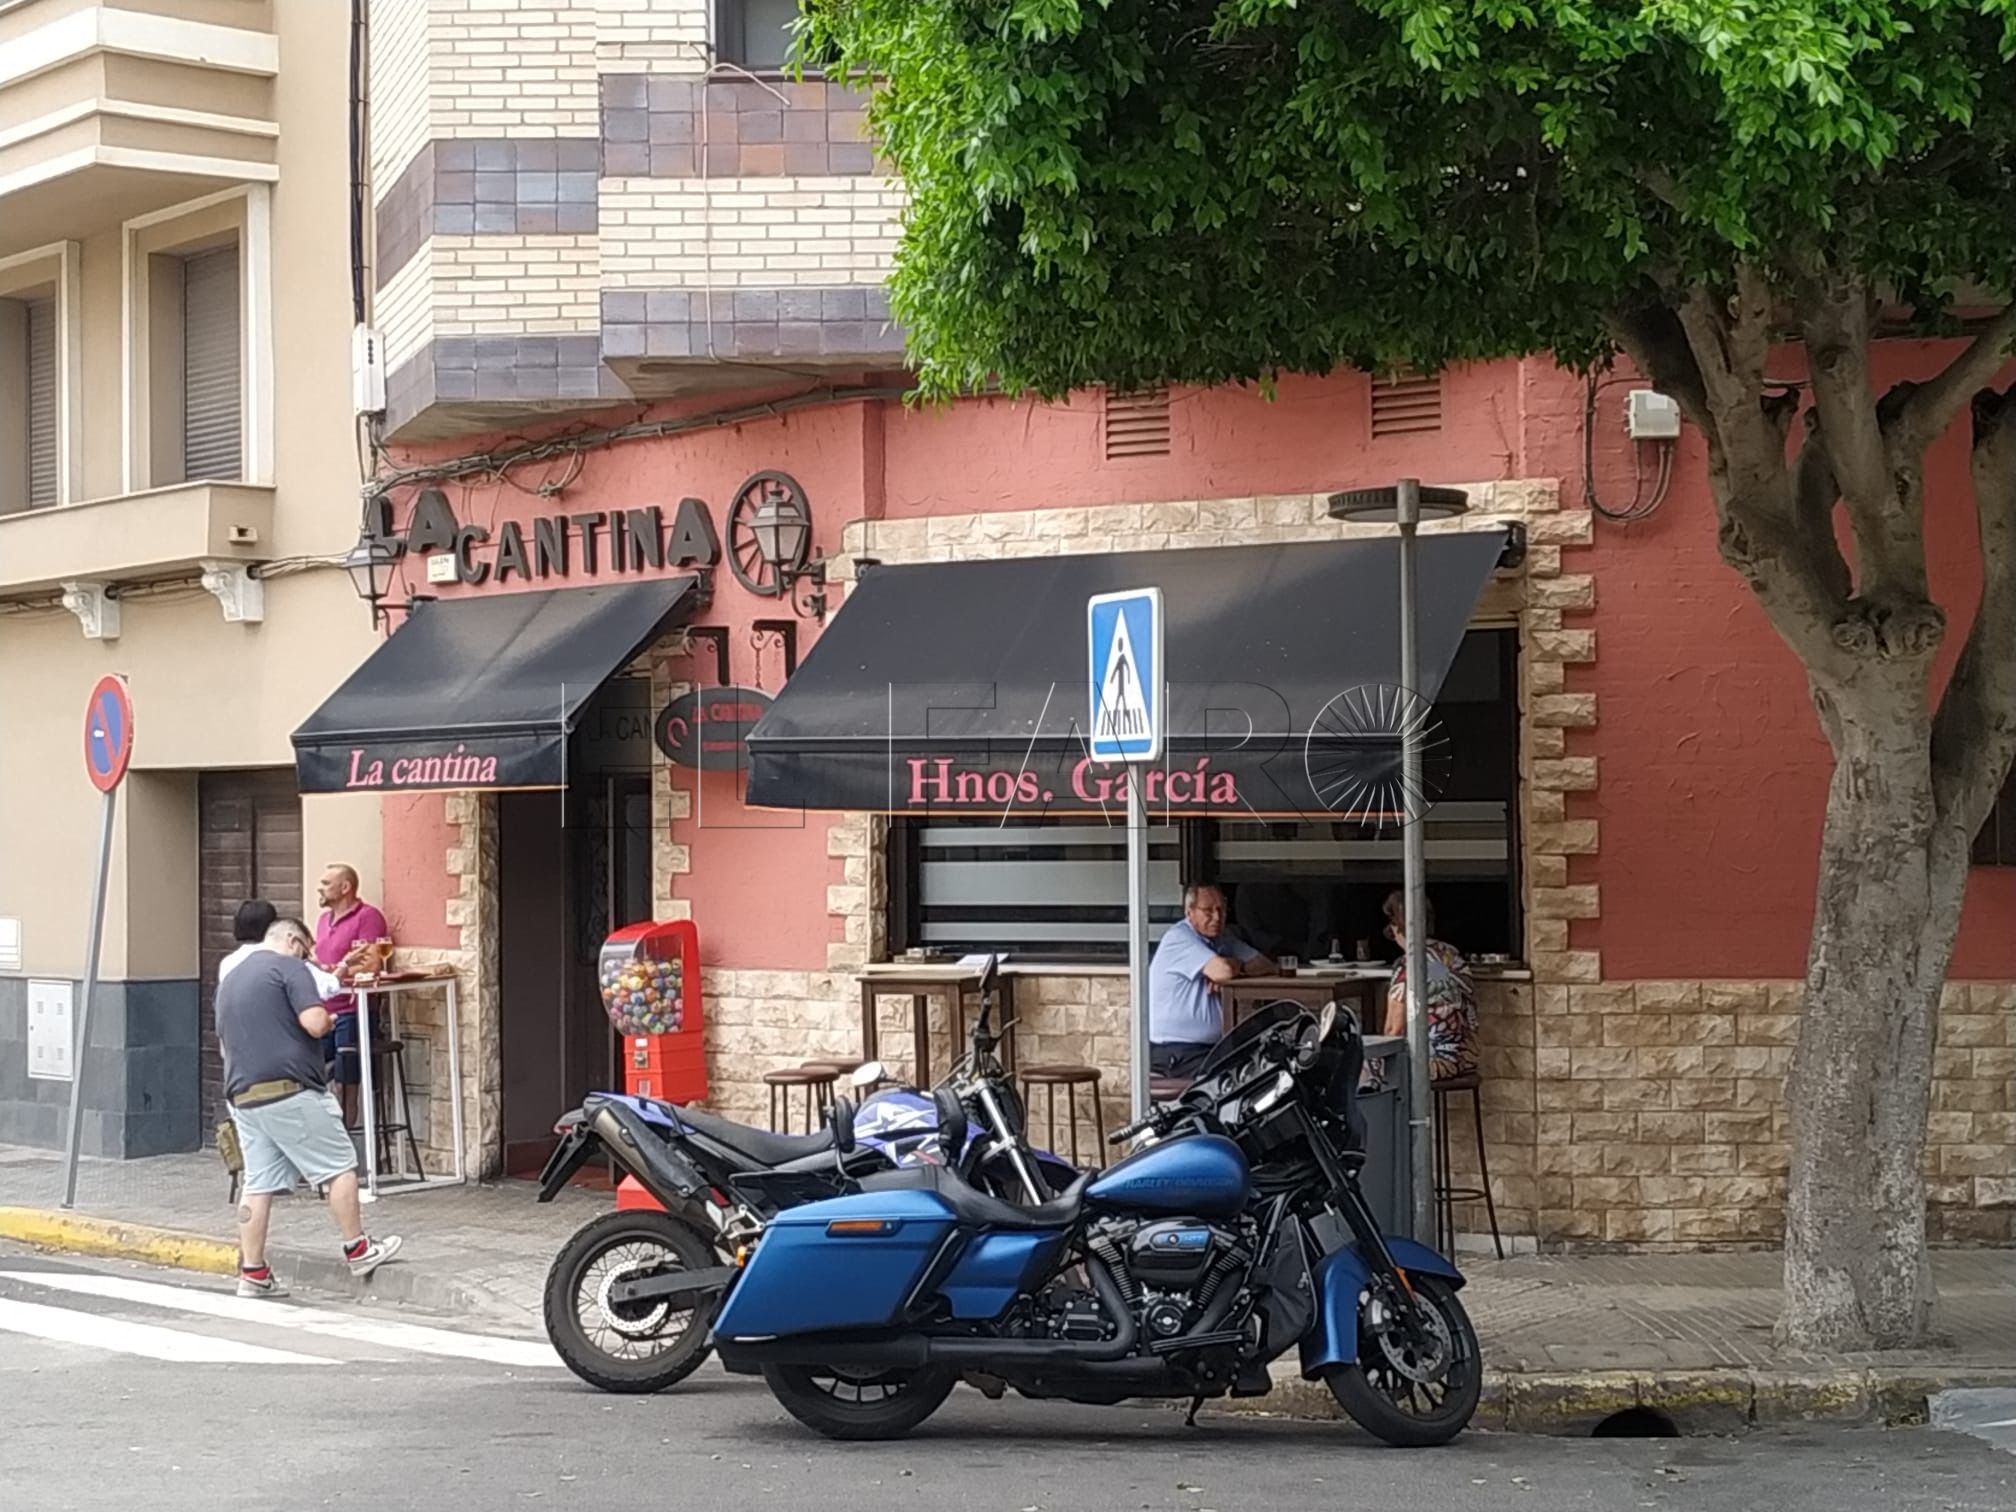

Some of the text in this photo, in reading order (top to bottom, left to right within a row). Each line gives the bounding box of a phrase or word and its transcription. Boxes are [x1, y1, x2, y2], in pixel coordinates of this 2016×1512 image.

[367, 488, 720, 583] LA CANTINA
[346, 743, 498, 787] La cantina
[906, 757, 1054, 804] Hnos.
